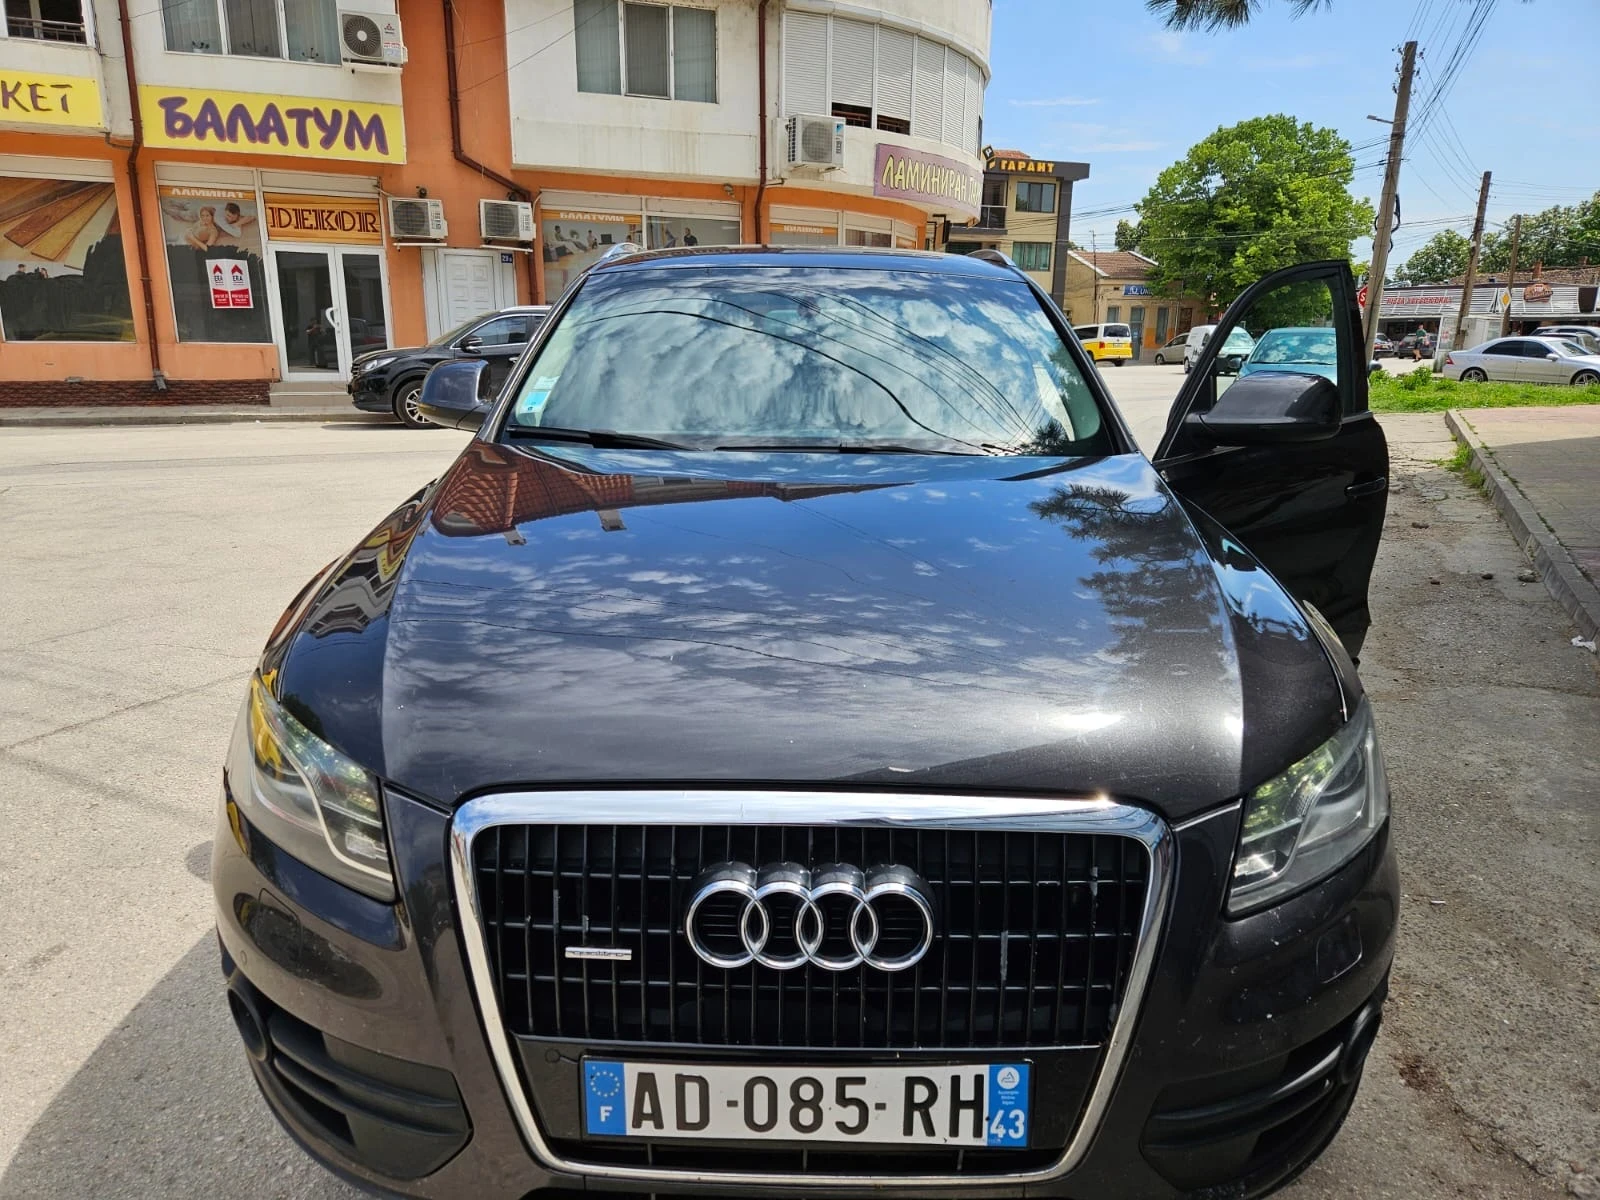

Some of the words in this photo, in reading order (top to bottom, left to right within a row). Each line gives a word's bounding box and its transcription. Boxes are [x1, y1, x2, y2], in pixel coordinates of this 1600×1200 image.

[157, 96, 390, 157] БАЛАТУМ
[881, 154, 967, 202] ЛАМИНИРАН
[1000, 160, 1055, 174] ГАРАНТ
[171, 187, 244, 199] ЛАМИНАТ
[267, 206, 380, 233] DEKOR
[600, 1105, 613, 1123] F
[990, 1109, 1025, 1139] 43
